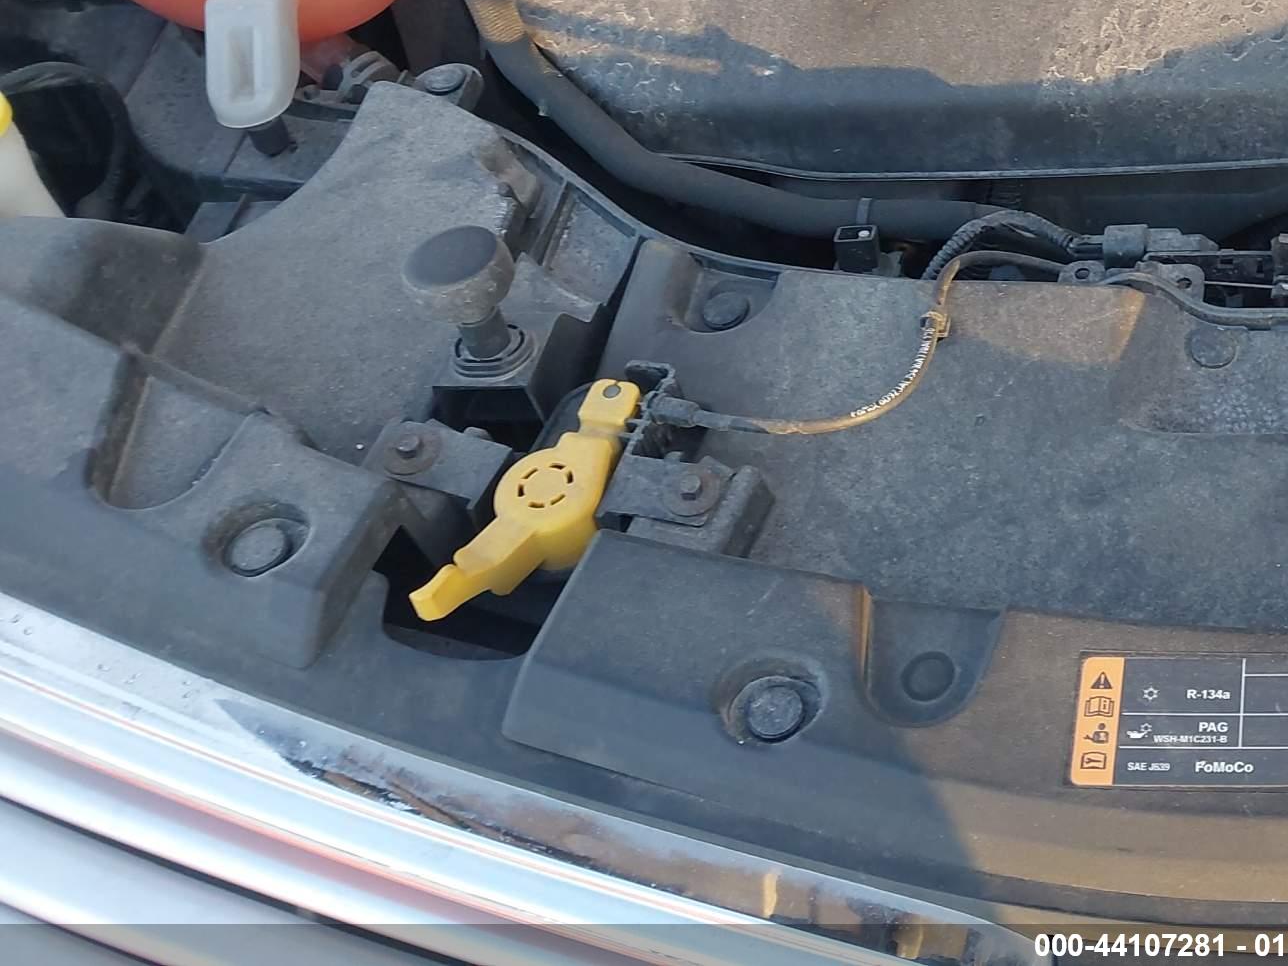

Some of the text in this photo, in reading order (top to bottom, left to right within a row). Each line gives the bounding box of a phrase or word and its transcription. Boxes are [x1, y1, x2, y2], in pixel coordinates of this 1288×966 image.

[1186, 688, 1231, 699] R-134a
[1199, 721, 1228, 732] PAG
[1127, 762, 1147, 771] SAE
[1195, 761, 1254, 772] FoMoCo
